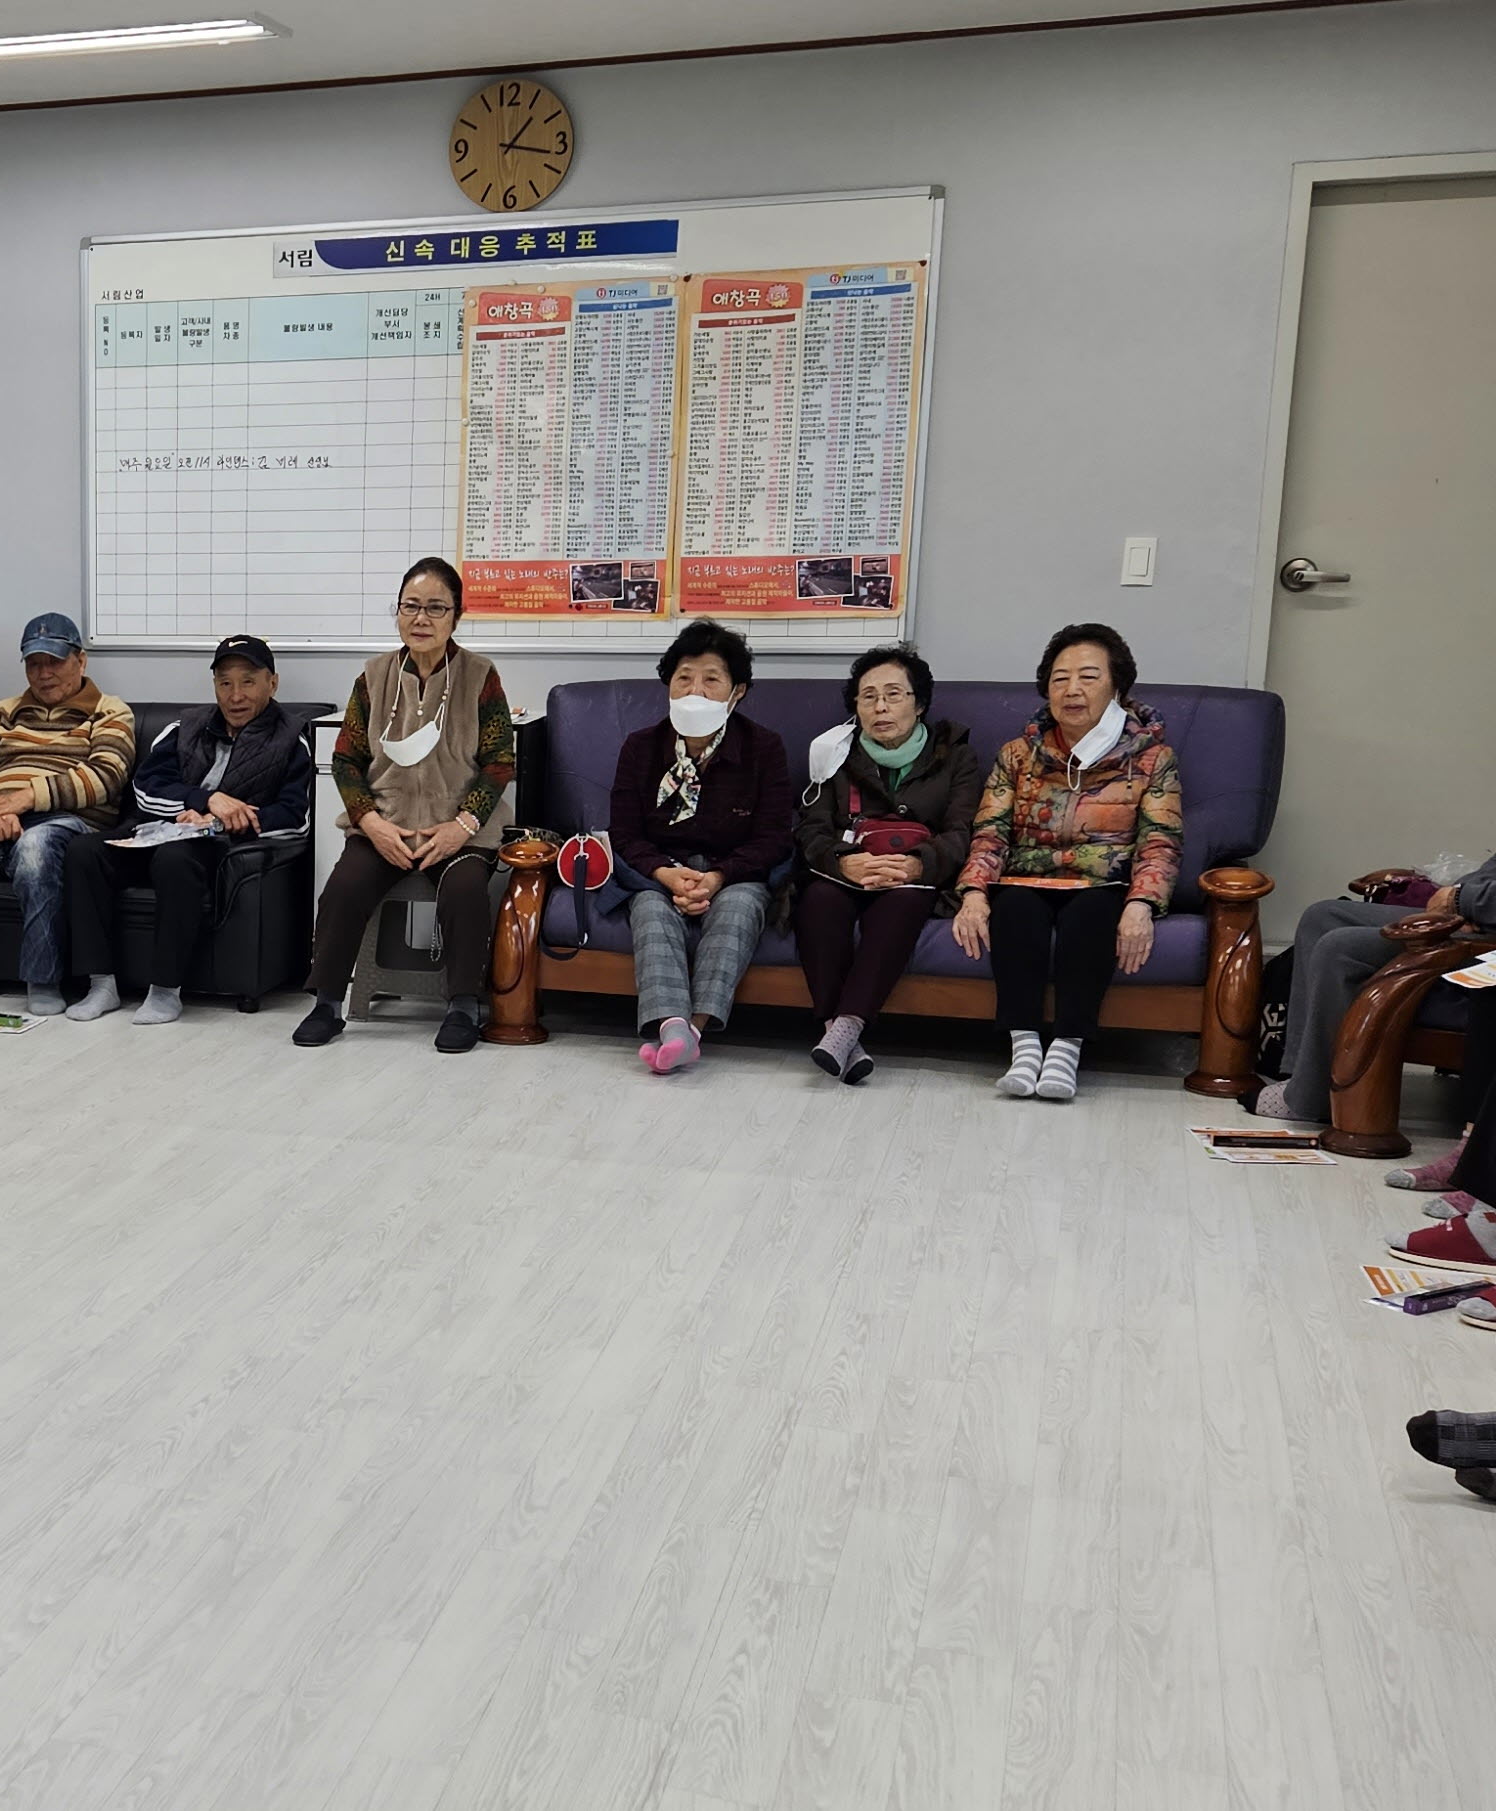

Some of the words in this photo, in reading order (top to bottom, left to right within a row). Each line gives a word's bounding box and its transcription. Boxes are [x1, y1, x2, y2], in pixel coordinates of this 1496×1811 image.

[499, 82, 521, 108] 12
[454, 138, 469, 163] 9
[555, 131, 568, 155] 3
[502, 185, 517, 209] 6
[278, 249, 313, 268] 서림
[385, 238, 435, 263] 신속
[450, 235, 500, 258] 대응
[514, 230, 598, 256] 추적표
[101, 288, 144, 301] 서림산업
[424, 293, 441, 302] 24H
[712, 288, 762, 308] 애창곡
[488, 301, 534, 321] 애창곡
[384, 319, 400, 328] 부서
